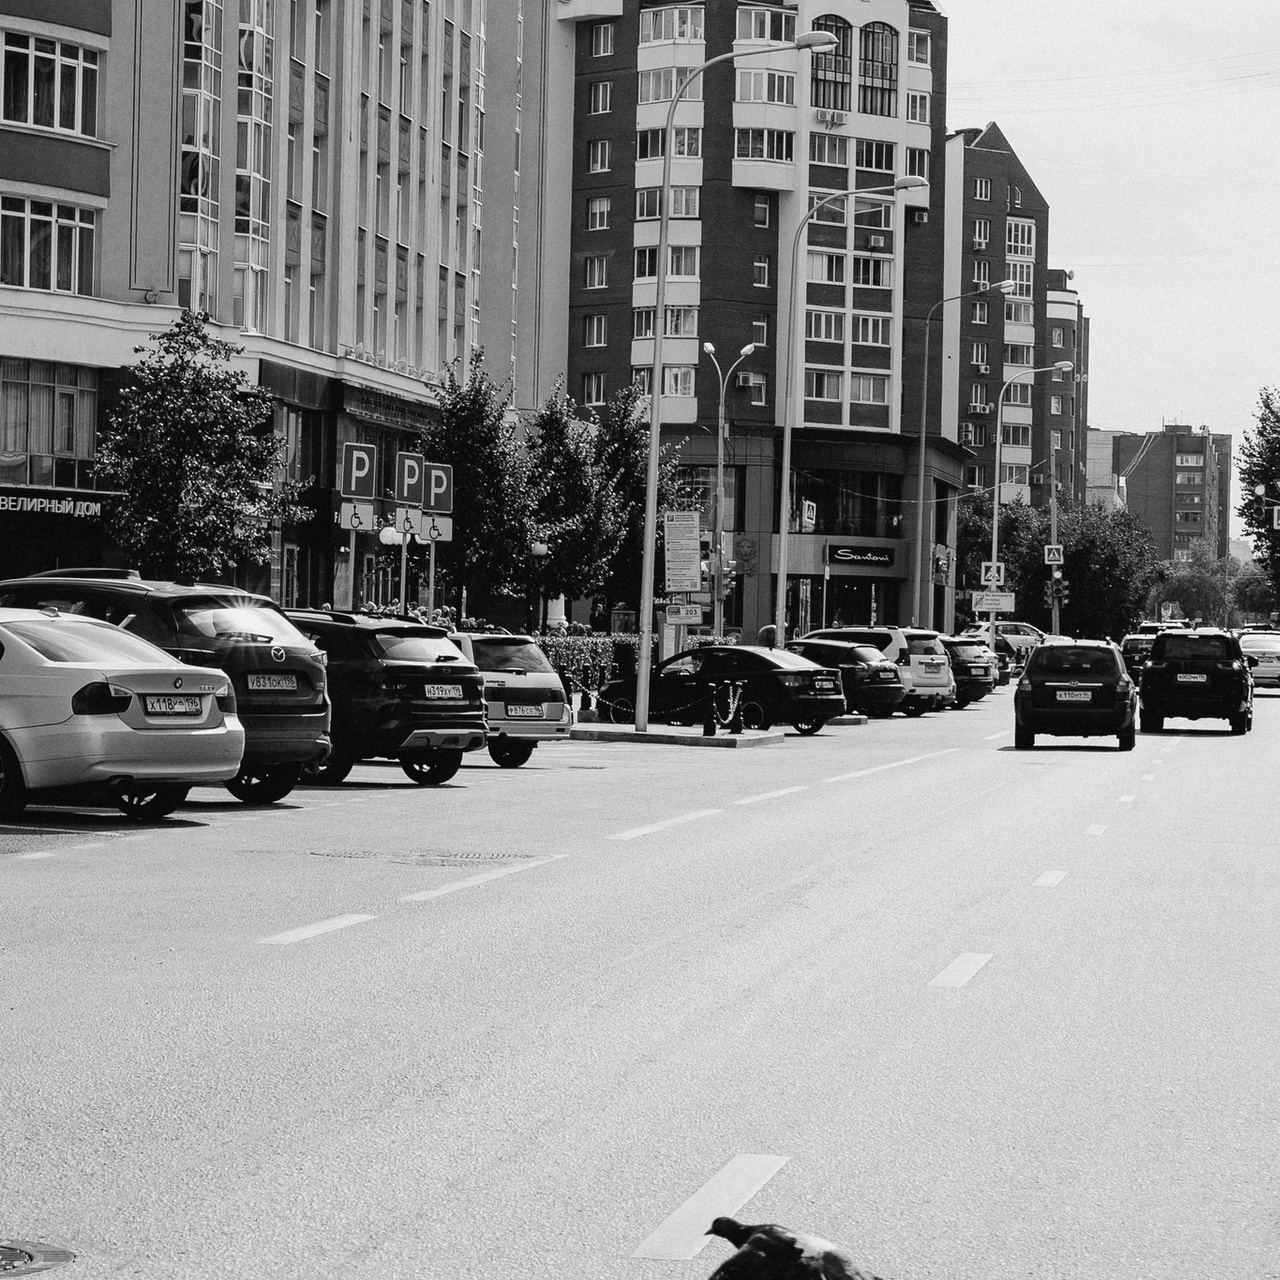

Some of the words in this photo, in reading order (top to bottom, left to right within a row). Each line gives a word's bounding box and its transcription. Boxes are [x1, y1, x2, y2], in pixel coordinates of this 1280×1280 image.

[351, 450, 370, 491] P
[403, 459, 419, 497] P
[430, 469, 448, 506] P
[74, 501, 101, 518] ДОМ
[834, 549, 890, 561] Santoni
